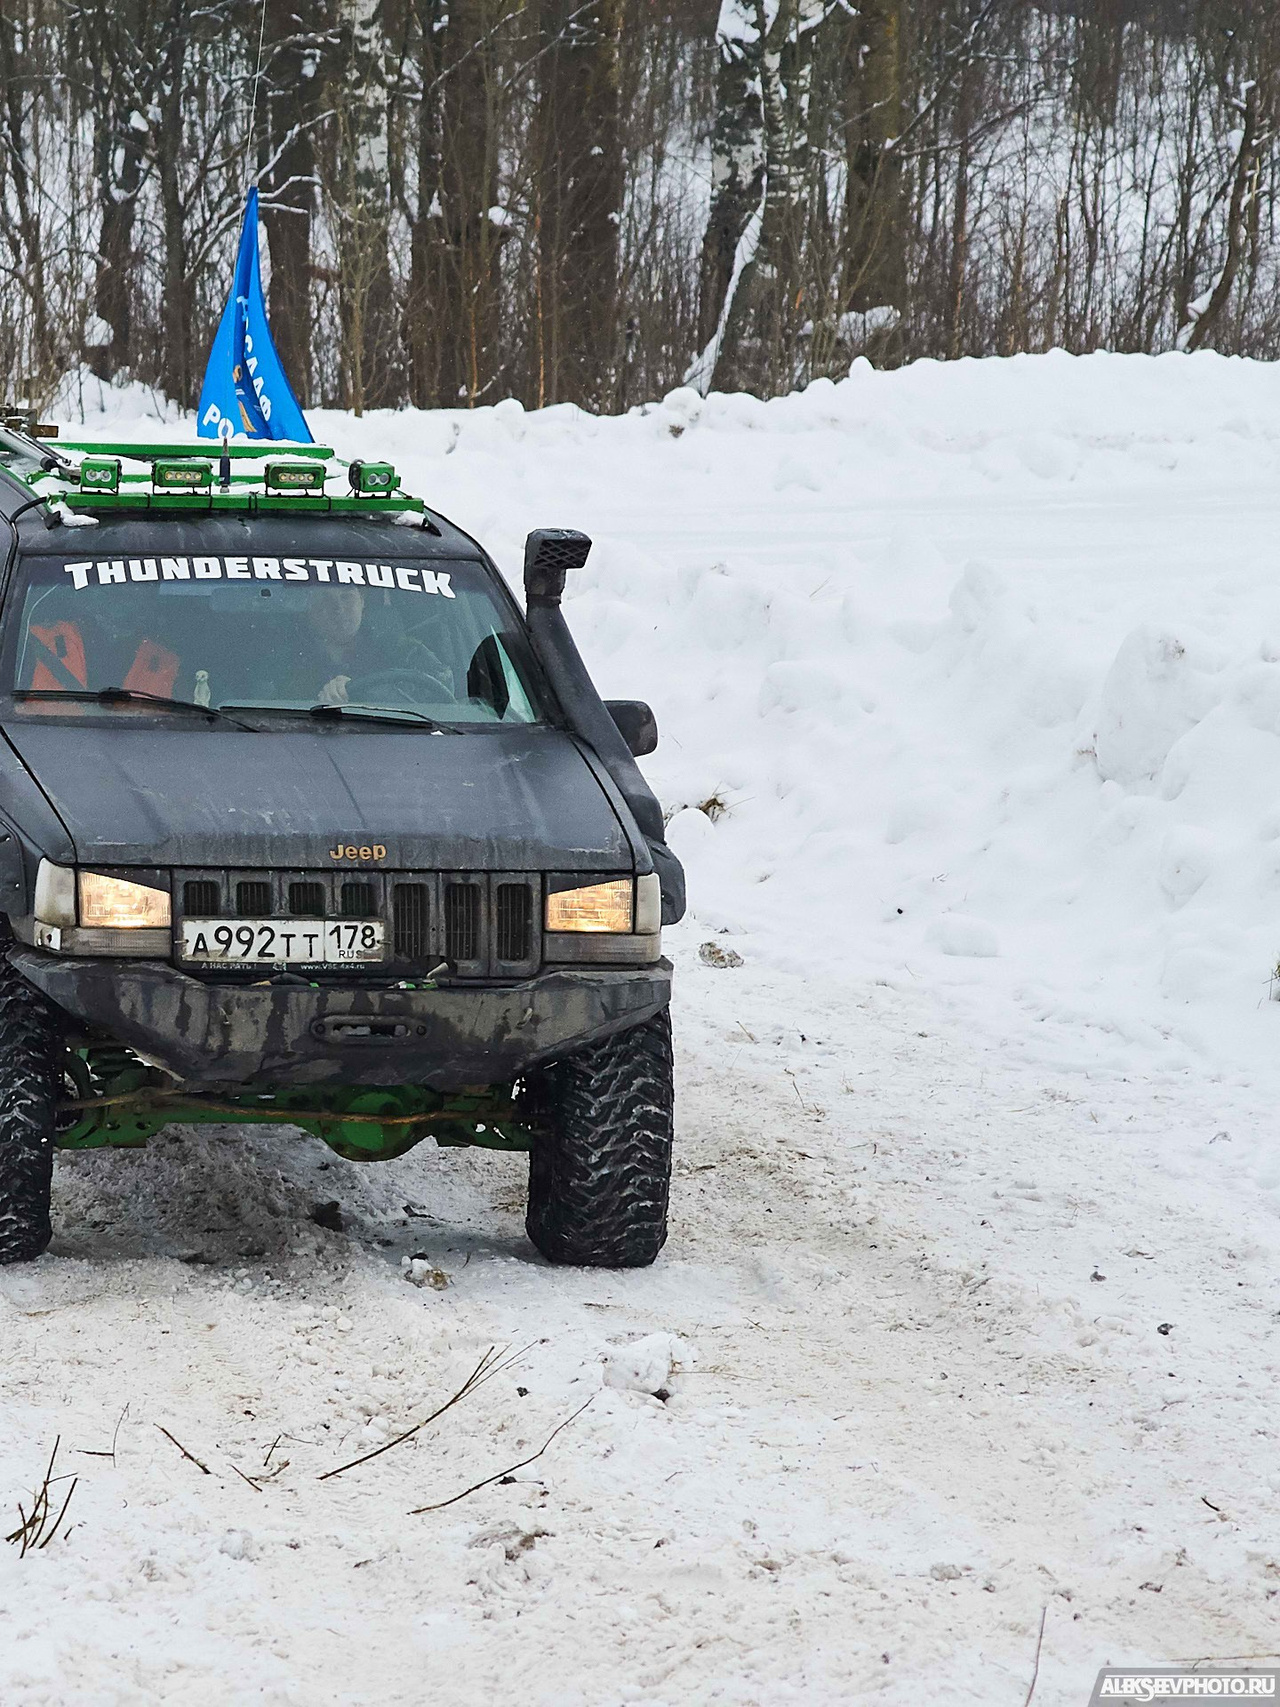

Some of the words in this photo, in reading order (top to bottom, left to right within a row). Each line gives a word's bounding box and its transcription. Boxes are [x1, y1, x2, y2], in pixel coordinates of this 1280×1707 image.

[64, 556, 456, 598] THUNDERSTRUCK
[329, 844, 387, 861] Jeep
[329, 925, 377, 949] 178
[338, 949, 362, 959] RUS
